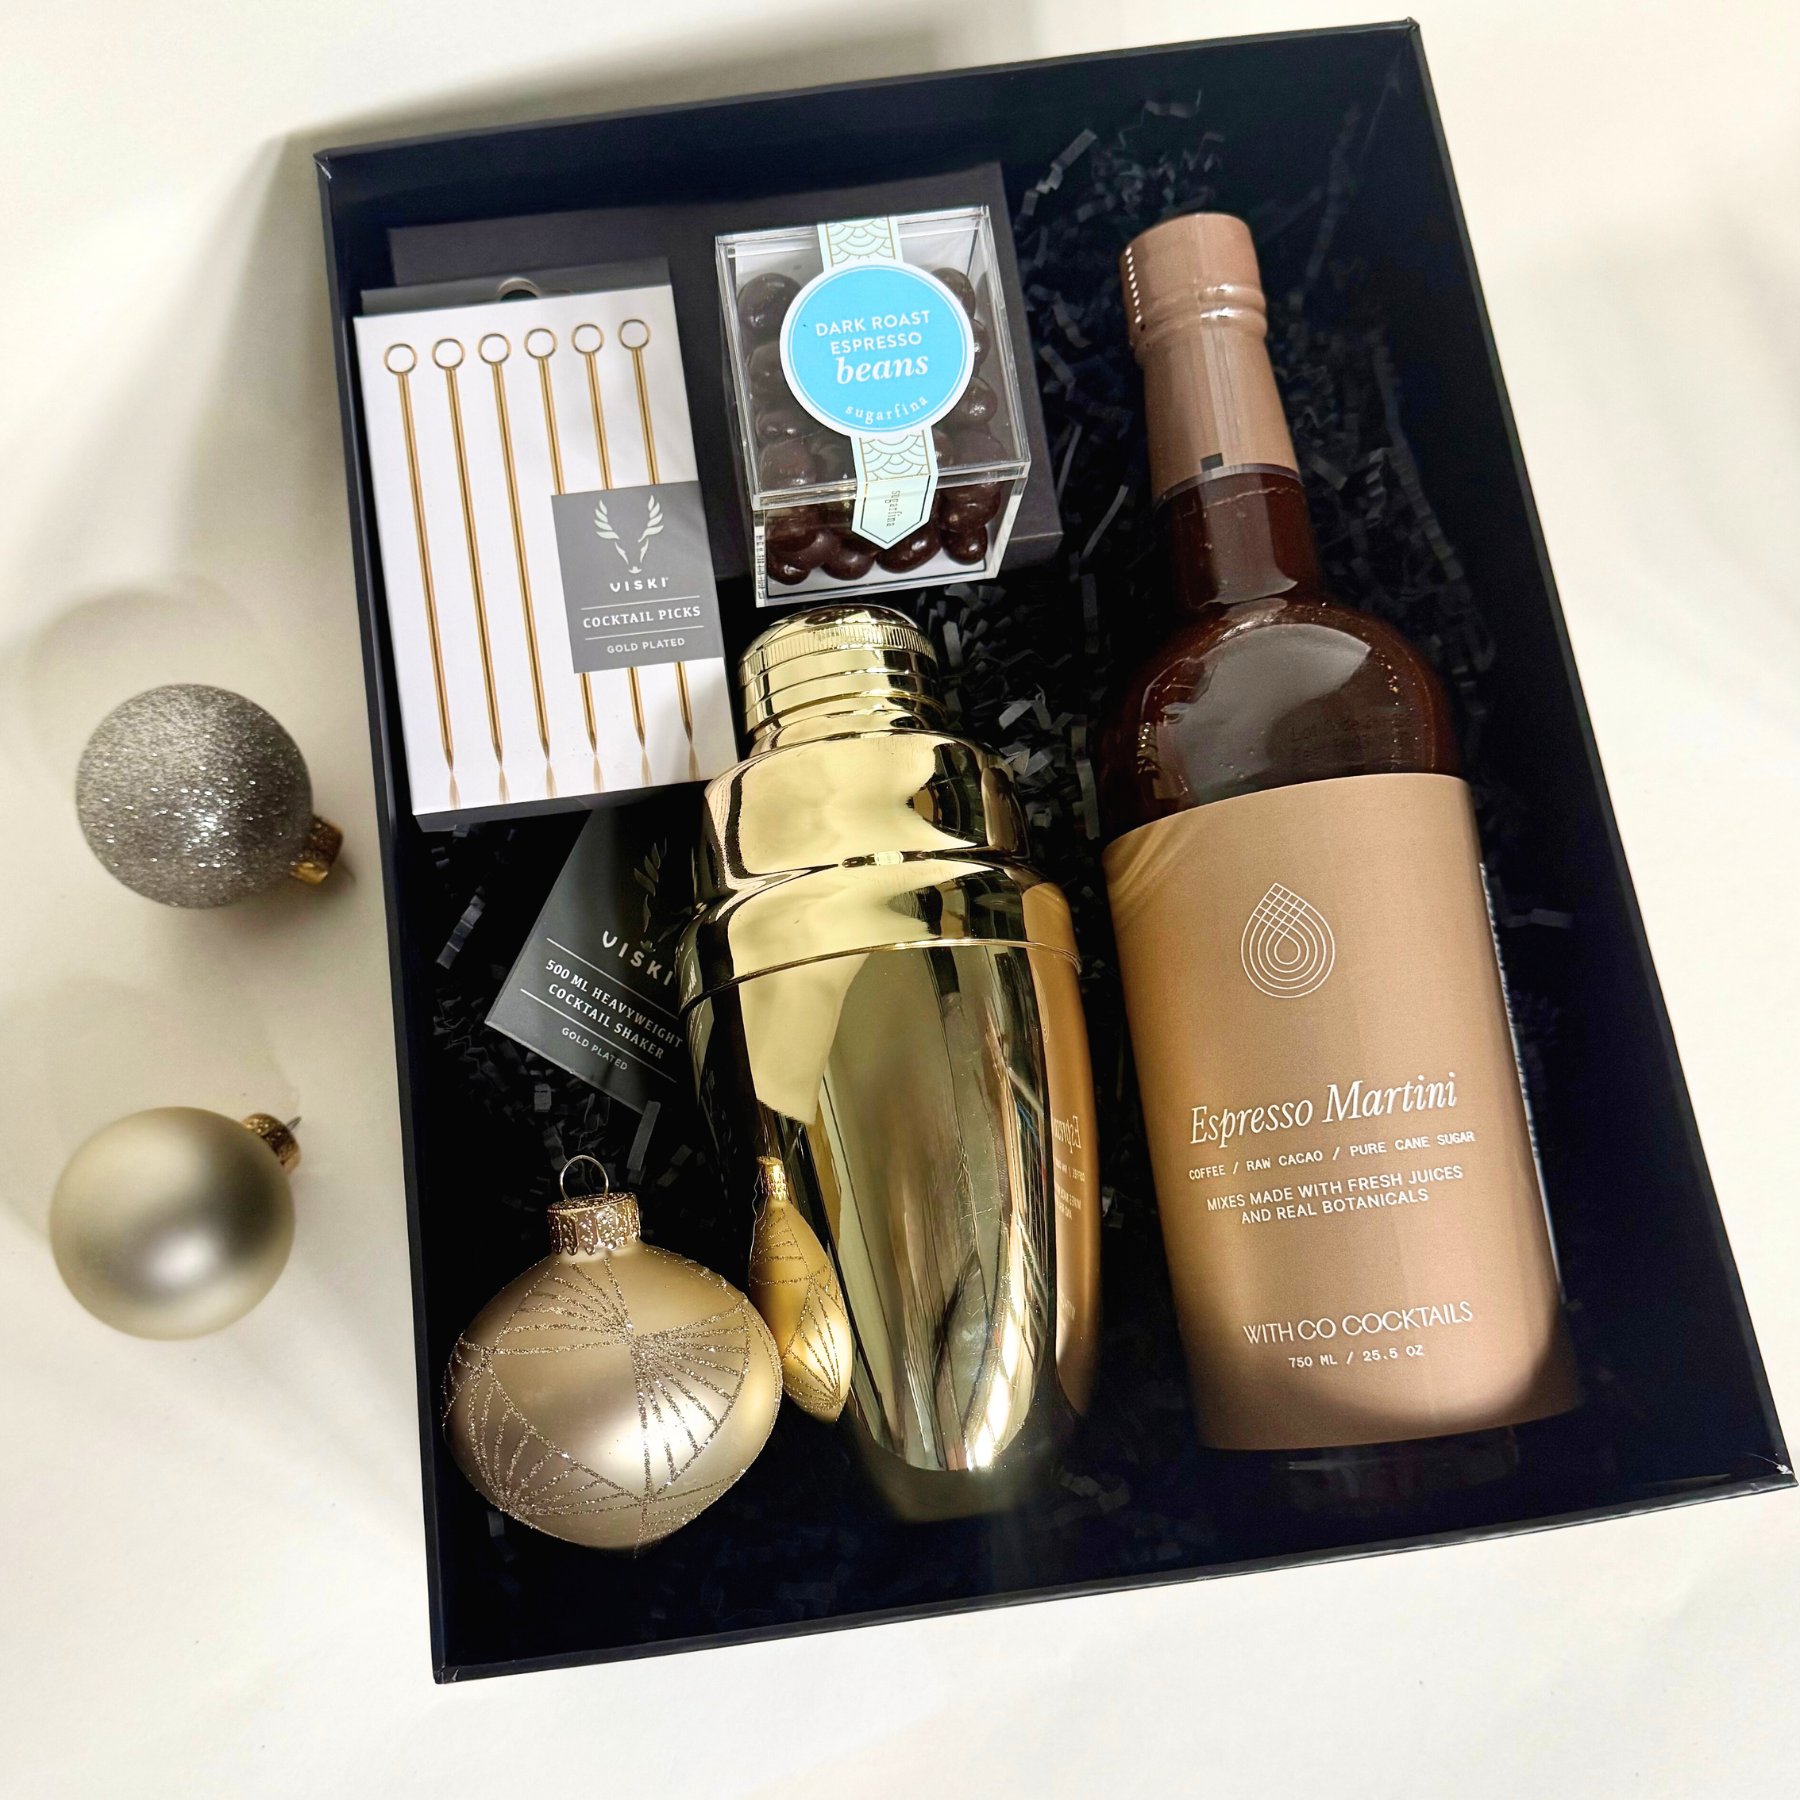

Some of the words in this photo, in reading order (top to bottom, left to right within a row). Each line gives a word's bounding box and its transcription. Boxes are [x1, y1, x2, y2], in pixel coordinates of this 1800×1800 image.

[816, 319, 866, 336] DARK
[872, 310, 931, 330] ROAST
[830, 332, 922, 355] ESPRESSO
[835, 356, 929, 385] beans
[845, 397, 928, 424] sugarfina
[609, 577, 668, 592] VISKI
[583, 612, 654, 628] COCKTAIL
[658, 606, 701, 620] PICKS
[607, 642, 638, 654] GOLD
[642, 638, 685, 650] PLATED
[602, 930, 674, 986] VISKI
[545, 959, 571, 980] 500
[570, 974, 589, 993] ML
[591, 988, 683, 1048] HEAVYWEIGHT
[548, 983, 610, 1027] COCKTAIL
[614, 1023, 664, 1059] SHAKER
[561, 1027, 590, 1047] GOLD
[591, 1044, 628, 1070] PLATED
[1190, 1099, 1314, 1148] Espresso
[1321, 1071, 1457, 1123] Martini
[1188, 1164, 1226, 1180] COFFEE
[1232, 1162, 1239, 1175] /
[1246, 1157, 1271, 1172] RAW
[1278, 1149, 1323, 1167] CACAO
[1332, 1147, 1341, 1160] /
[1350, 1141, 1387, 1157] PURE
[1394, 1136, 1430, 1151] CANE
[1437, 1130, 1476, 1146] SUGAR
[1206, 1193, 1246, 1212] MIXES
[1249, 1187, 1293, 1207] MADE
[1297, 1181, 1343, 1200] WITH
[1348, 1173, 1403, 1193] FRESH
[1408, 1165, 1463, 1185] JUICES
[1241, 1208, 1272, 1225] AND
[1277, 1201, 1317, 1221] REAL
[1323, 1188, 1429, 1214] BOTANICALS
[1242, 1321, 1294, 1344] WITH
[1297, 1317, 1336, 1340] CO
[1342, 1301, 1474, 1336] COCKTAILS
[1288, 1356, 1313, 1368] 750
[1320, 1354, 1338, 1366] ML
[1346, 1351, 1353, 1365] /
[1362, 1347, 1398, 1362] 25.5
[1406, 1344, 1425, 1357] OZ
